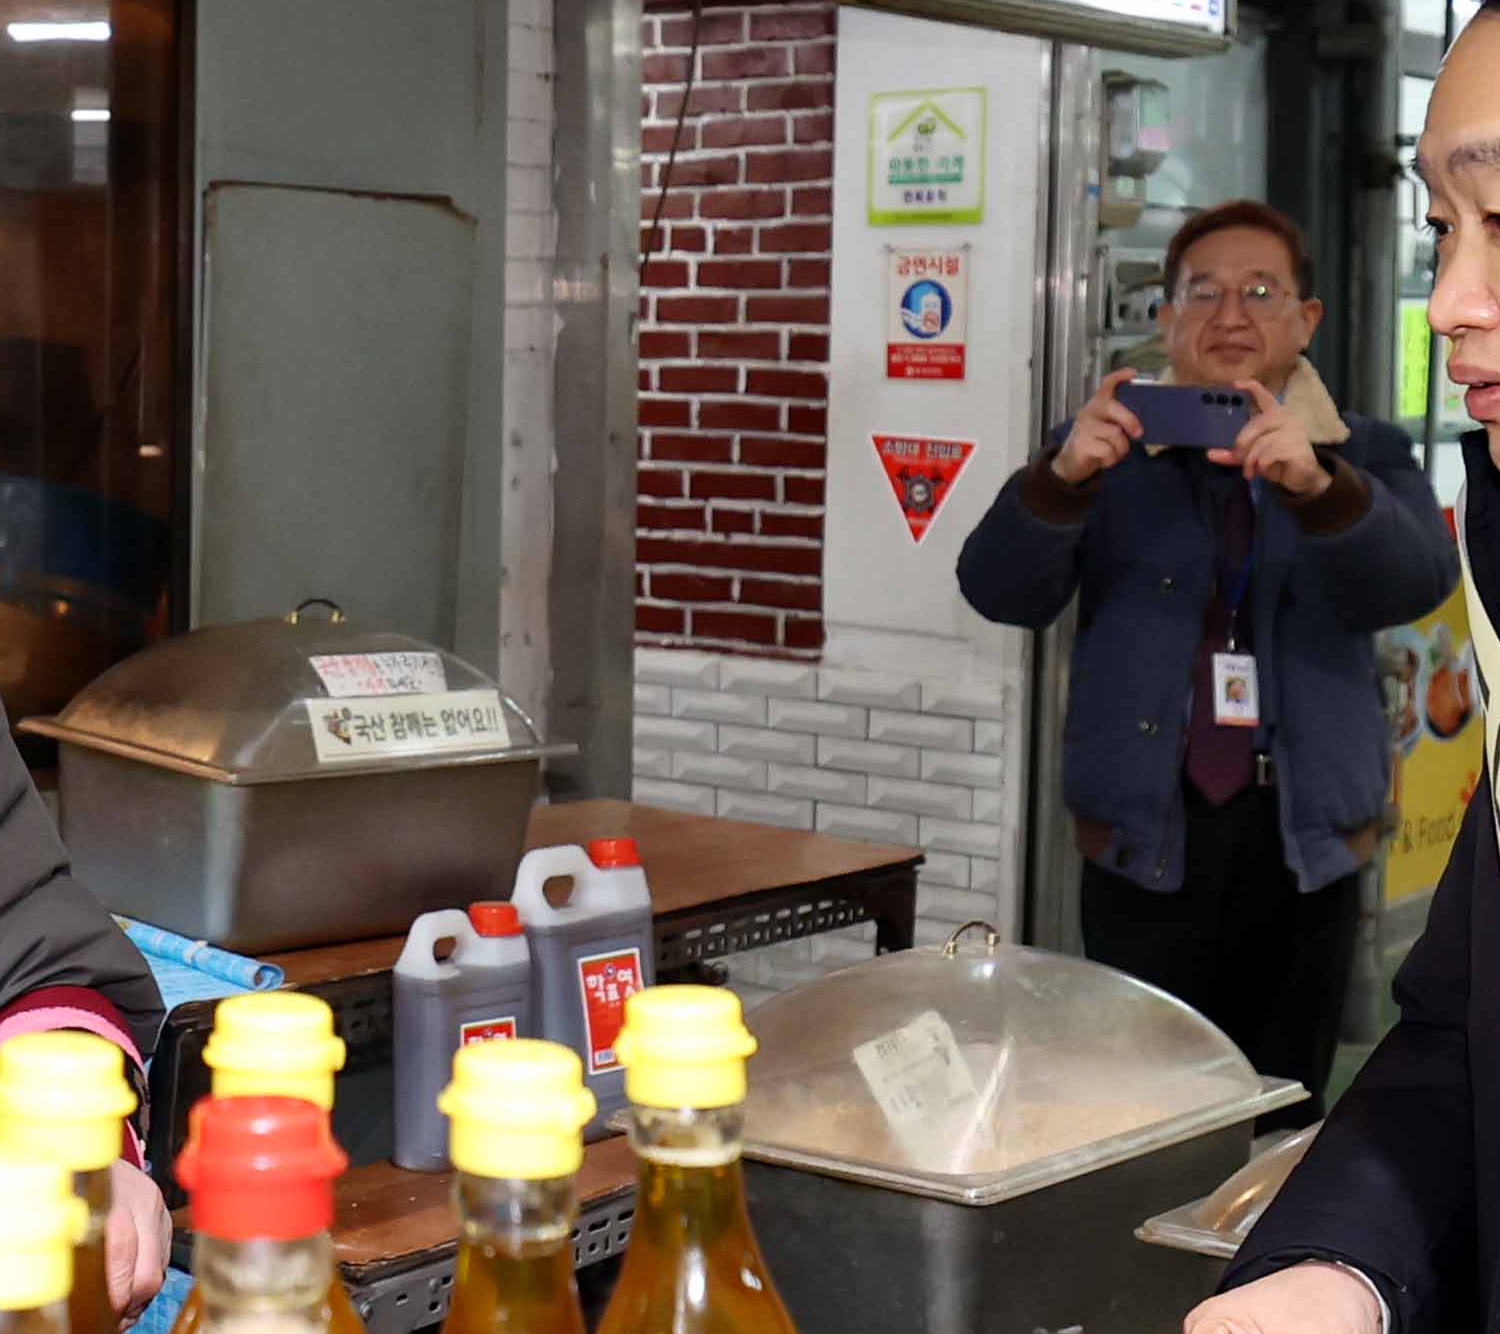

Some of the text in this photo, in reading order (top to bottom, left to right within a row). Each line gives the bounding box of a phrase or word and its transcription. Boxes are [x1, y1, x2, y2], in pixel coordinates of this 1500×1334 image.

[896, 256, 961, 276] 금연시설
[355, 713, 386, 742] 국산
[391, 709, 437, 740] 참깨는
